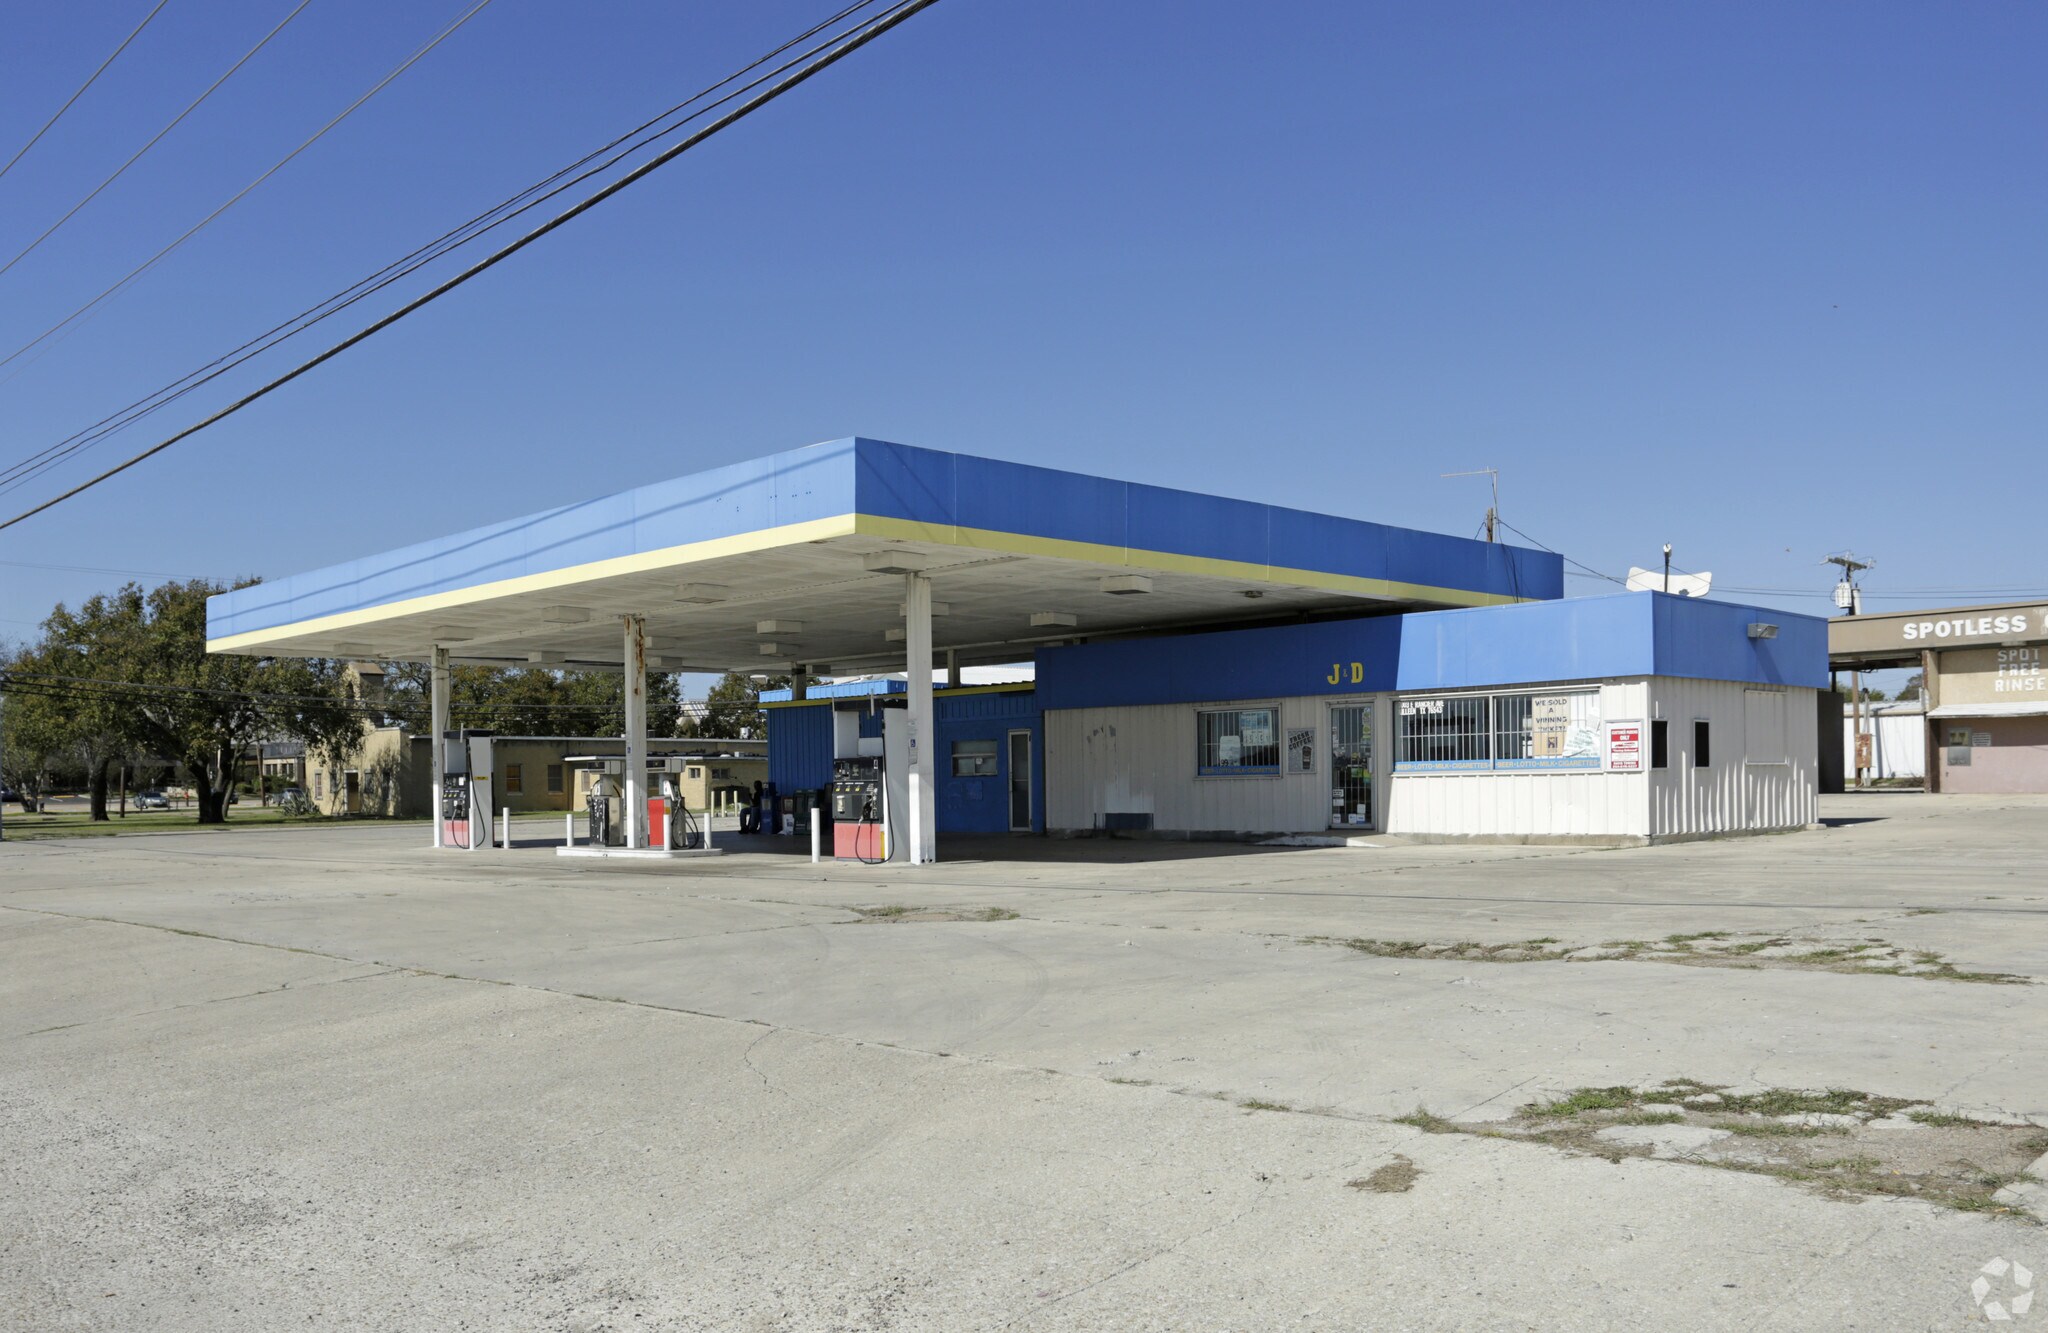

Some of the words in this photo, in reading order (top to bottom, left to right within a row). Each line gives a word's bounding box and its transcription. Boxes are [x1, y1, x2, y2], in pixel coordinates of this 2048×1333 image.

[1903, 615, 2027, 640] SPOTLESS
[1997, 648, 2040, 662] SPOT
[1327, 663, 1340, 685] J
[1350, 662, 1364, 684] D
[1998, 662, 2040, 677] FREE
[1995, 677, 2046, 692] RINSE
[1534, 699, 1546, 707] WE
[1547, 698, 1568, 706] SOLD
[1535, 716, 1568, 724] WINNING
[1289, 731, 1310, 744] FRESH
